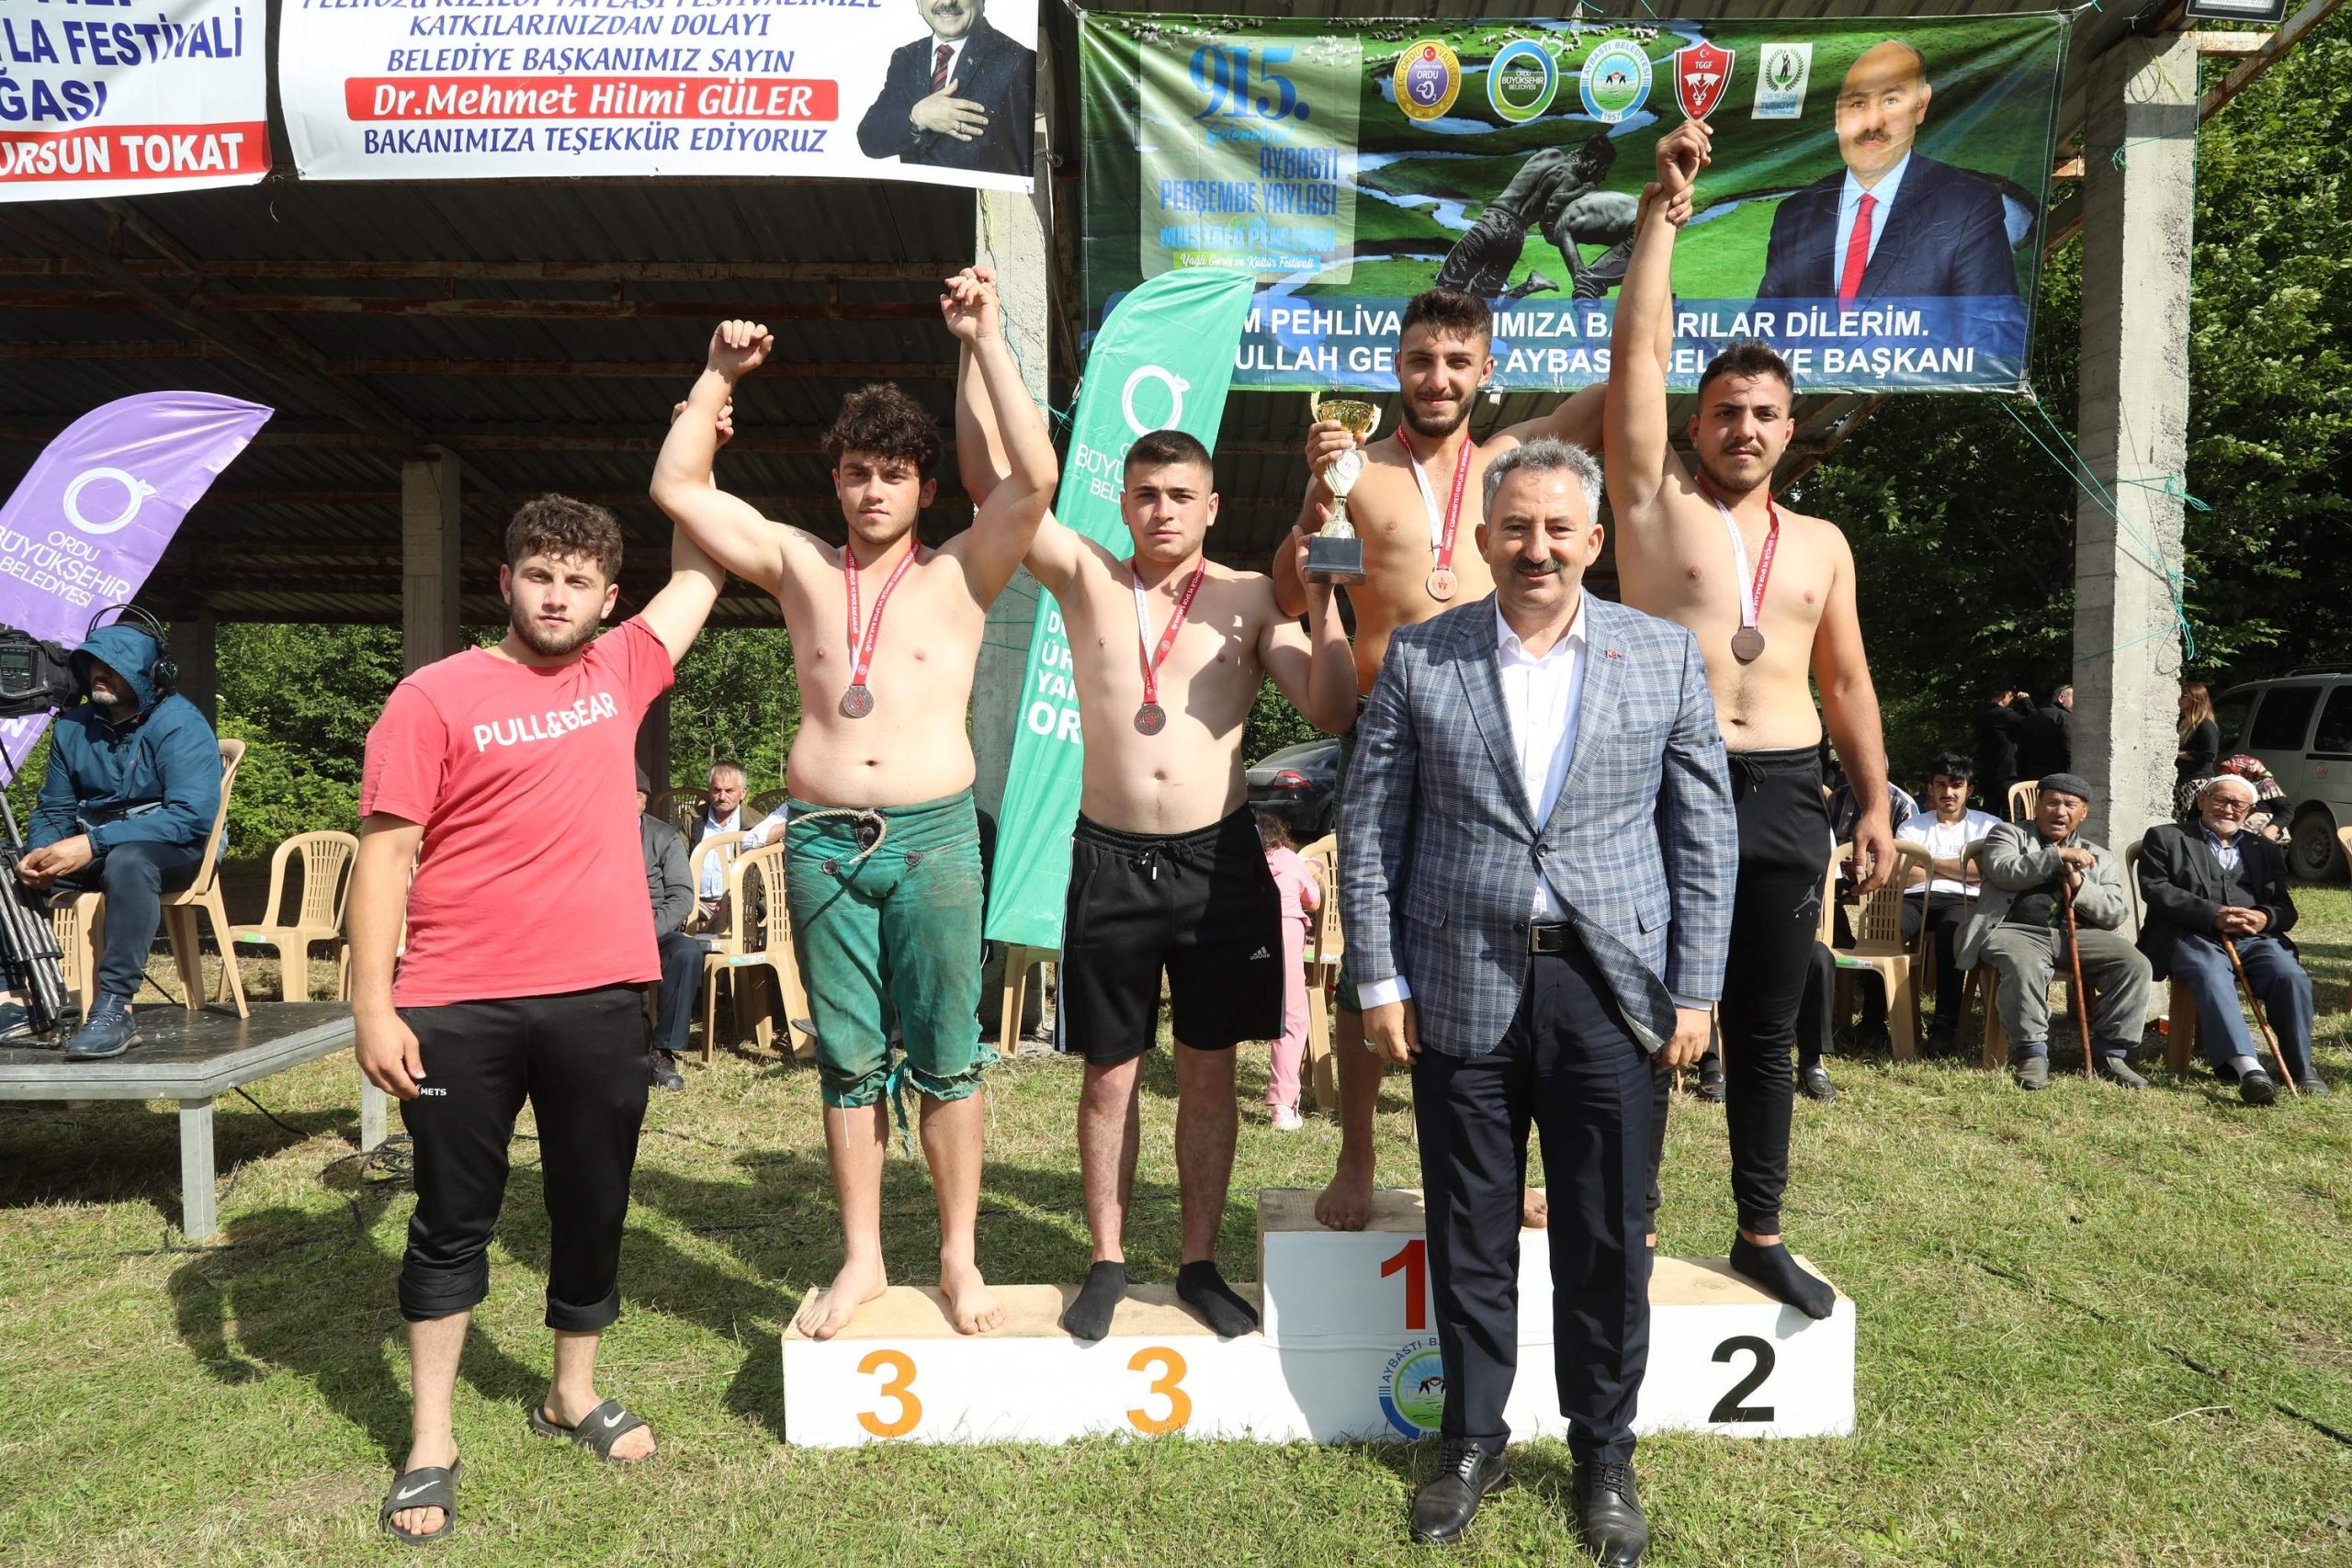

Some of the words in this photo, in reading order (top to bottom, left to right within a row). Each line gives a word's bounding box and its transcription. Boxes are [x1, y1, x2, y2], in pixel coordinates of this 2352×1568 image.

[0, 17, 60, 63] LA
[62, 6, 242, 66] FESTİVALİ
[410, 15, 664, 36] KATKILARINIZDAN
[671, 14, 771, 36] DOLAYI
[387, 42, 514, 72] BELEDİYE
[522, 47, 701, 75] BAŞKANIMIZ
[708, 49, 795, 73] SAYIN
[1417, 70, 1439, 79] ORDU
[1694, 61, 1713, 70] TGGF
[372, 84, 578, 116] Dr.Mehmet
[589, 83, 686, 114] Hilmi
[697, 77, 813, 117] GÜLER
[1189, 44, 1310, 121] 915.
[1603, 112, 1621, 121] 1957
[120, 132, 243, 173] TOKAT
[364, 128, 535, 154] BAKANIMIZA
[545, 121, 680, 155] TEŞEKKÜR
[690, 122, 828, 152] EDİYORUZ
[1260, 147, 1338, 180] AYBASTI
[1160, 179, 1257, 218] PERŞEMBE
[1262, 183, 1338, 215] YAYLASI
[1786, 305, 1928, 337] DİLERİM.
[1235, 344, 1338, 371] ULLAH
[1824, 347, 1974, 378] BAŞKANI
[48, 531, 100, 562] ORDU
[472, 692, 618, 752] PULL&BEAR
[1381, 1239, 1427, 1330] 1
[1382, 1339, 1422, 1383] AYBASTI
[1709, 1336, 1776, 1423] 2
[856, 1349, 922, 1438] 3
[1125, 1347, 1193, 1436] 3
